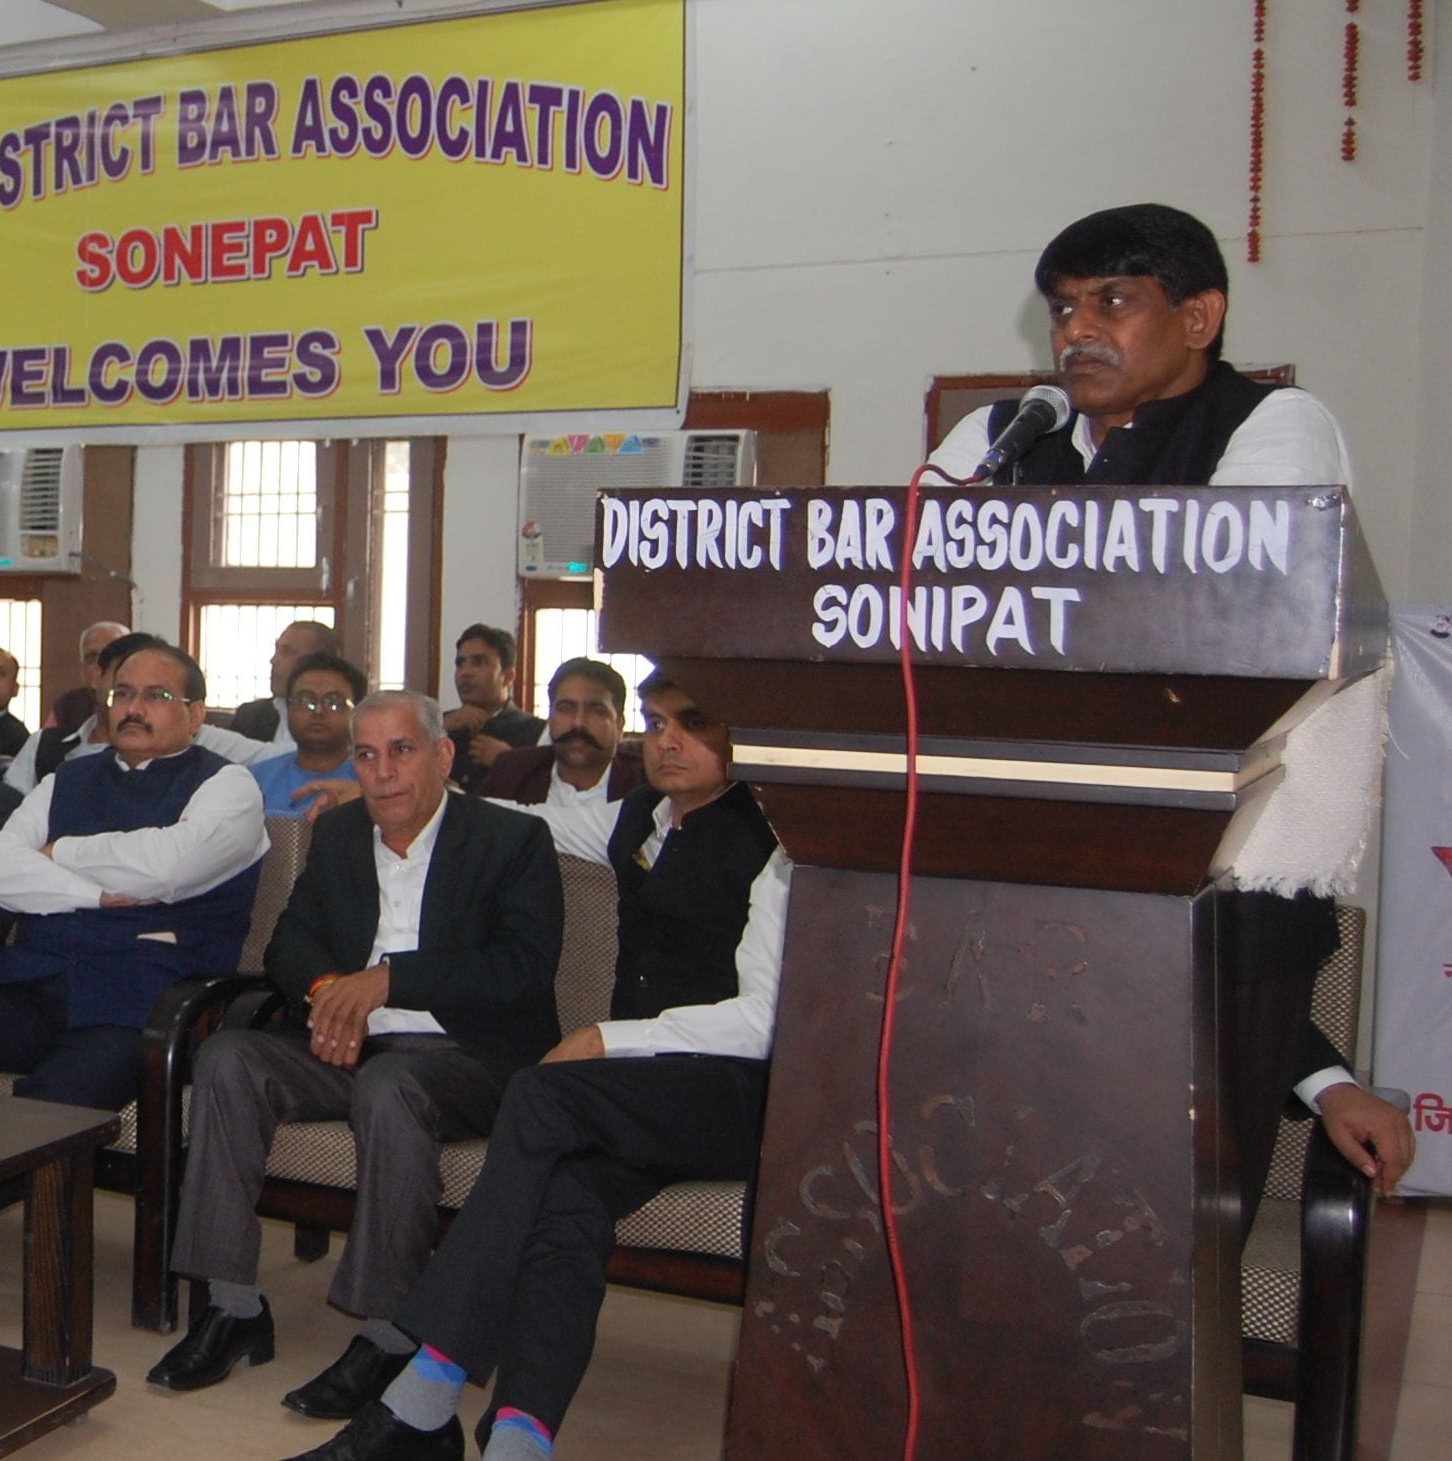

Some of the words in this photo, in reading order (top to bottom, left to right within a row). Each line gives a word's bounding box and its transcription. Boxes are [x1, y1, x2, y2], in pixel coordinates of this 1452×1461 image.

[177, 79, 280, 169] BAR
[291, 72, 673, 191] ASSOCIATION
[74, 208, 378, 293] SONEPAT
[364, 317, 535, 395] YOU
[601, 496, 791, 571] DISTRICT
[807, 496, 896, 572] BAR
[912, 497, 1291, 576] ASSOCIATION
[811, 584, 1082, 656] SONIPAT
